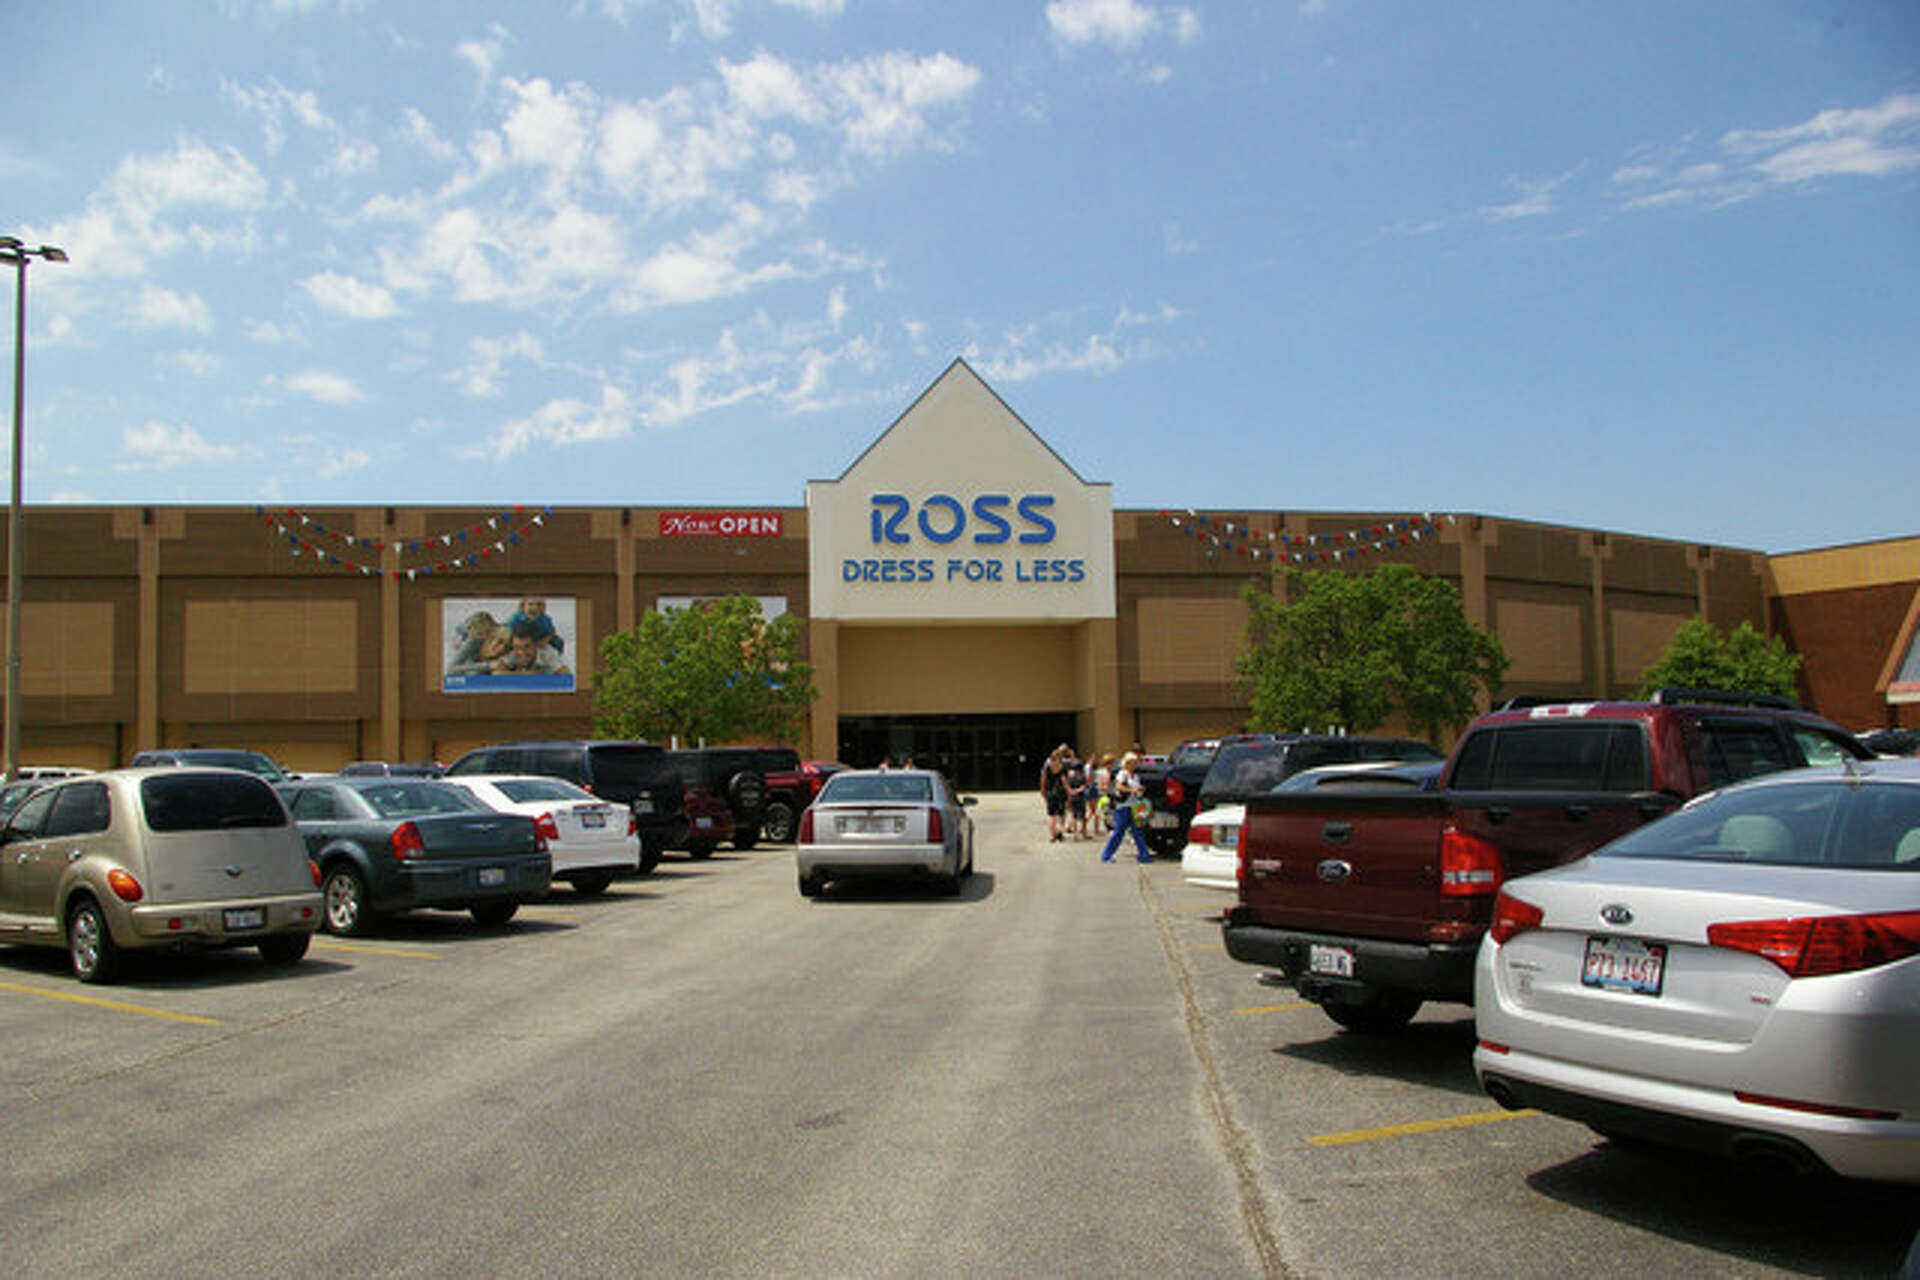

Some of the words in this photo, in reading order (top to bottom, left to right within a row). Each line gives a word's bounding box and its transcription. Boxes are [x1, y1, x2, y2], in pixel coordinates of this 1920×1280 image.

[662, 515, 719, 534] Now
[720, 517, 778, 533] OPEN
[871, 493, 1057, 545] ROSS
[842, 558, 936, 583] DRESS
[946, 558, 1003, 583] FOR
[1015, 558, 1087, 583] LESS
